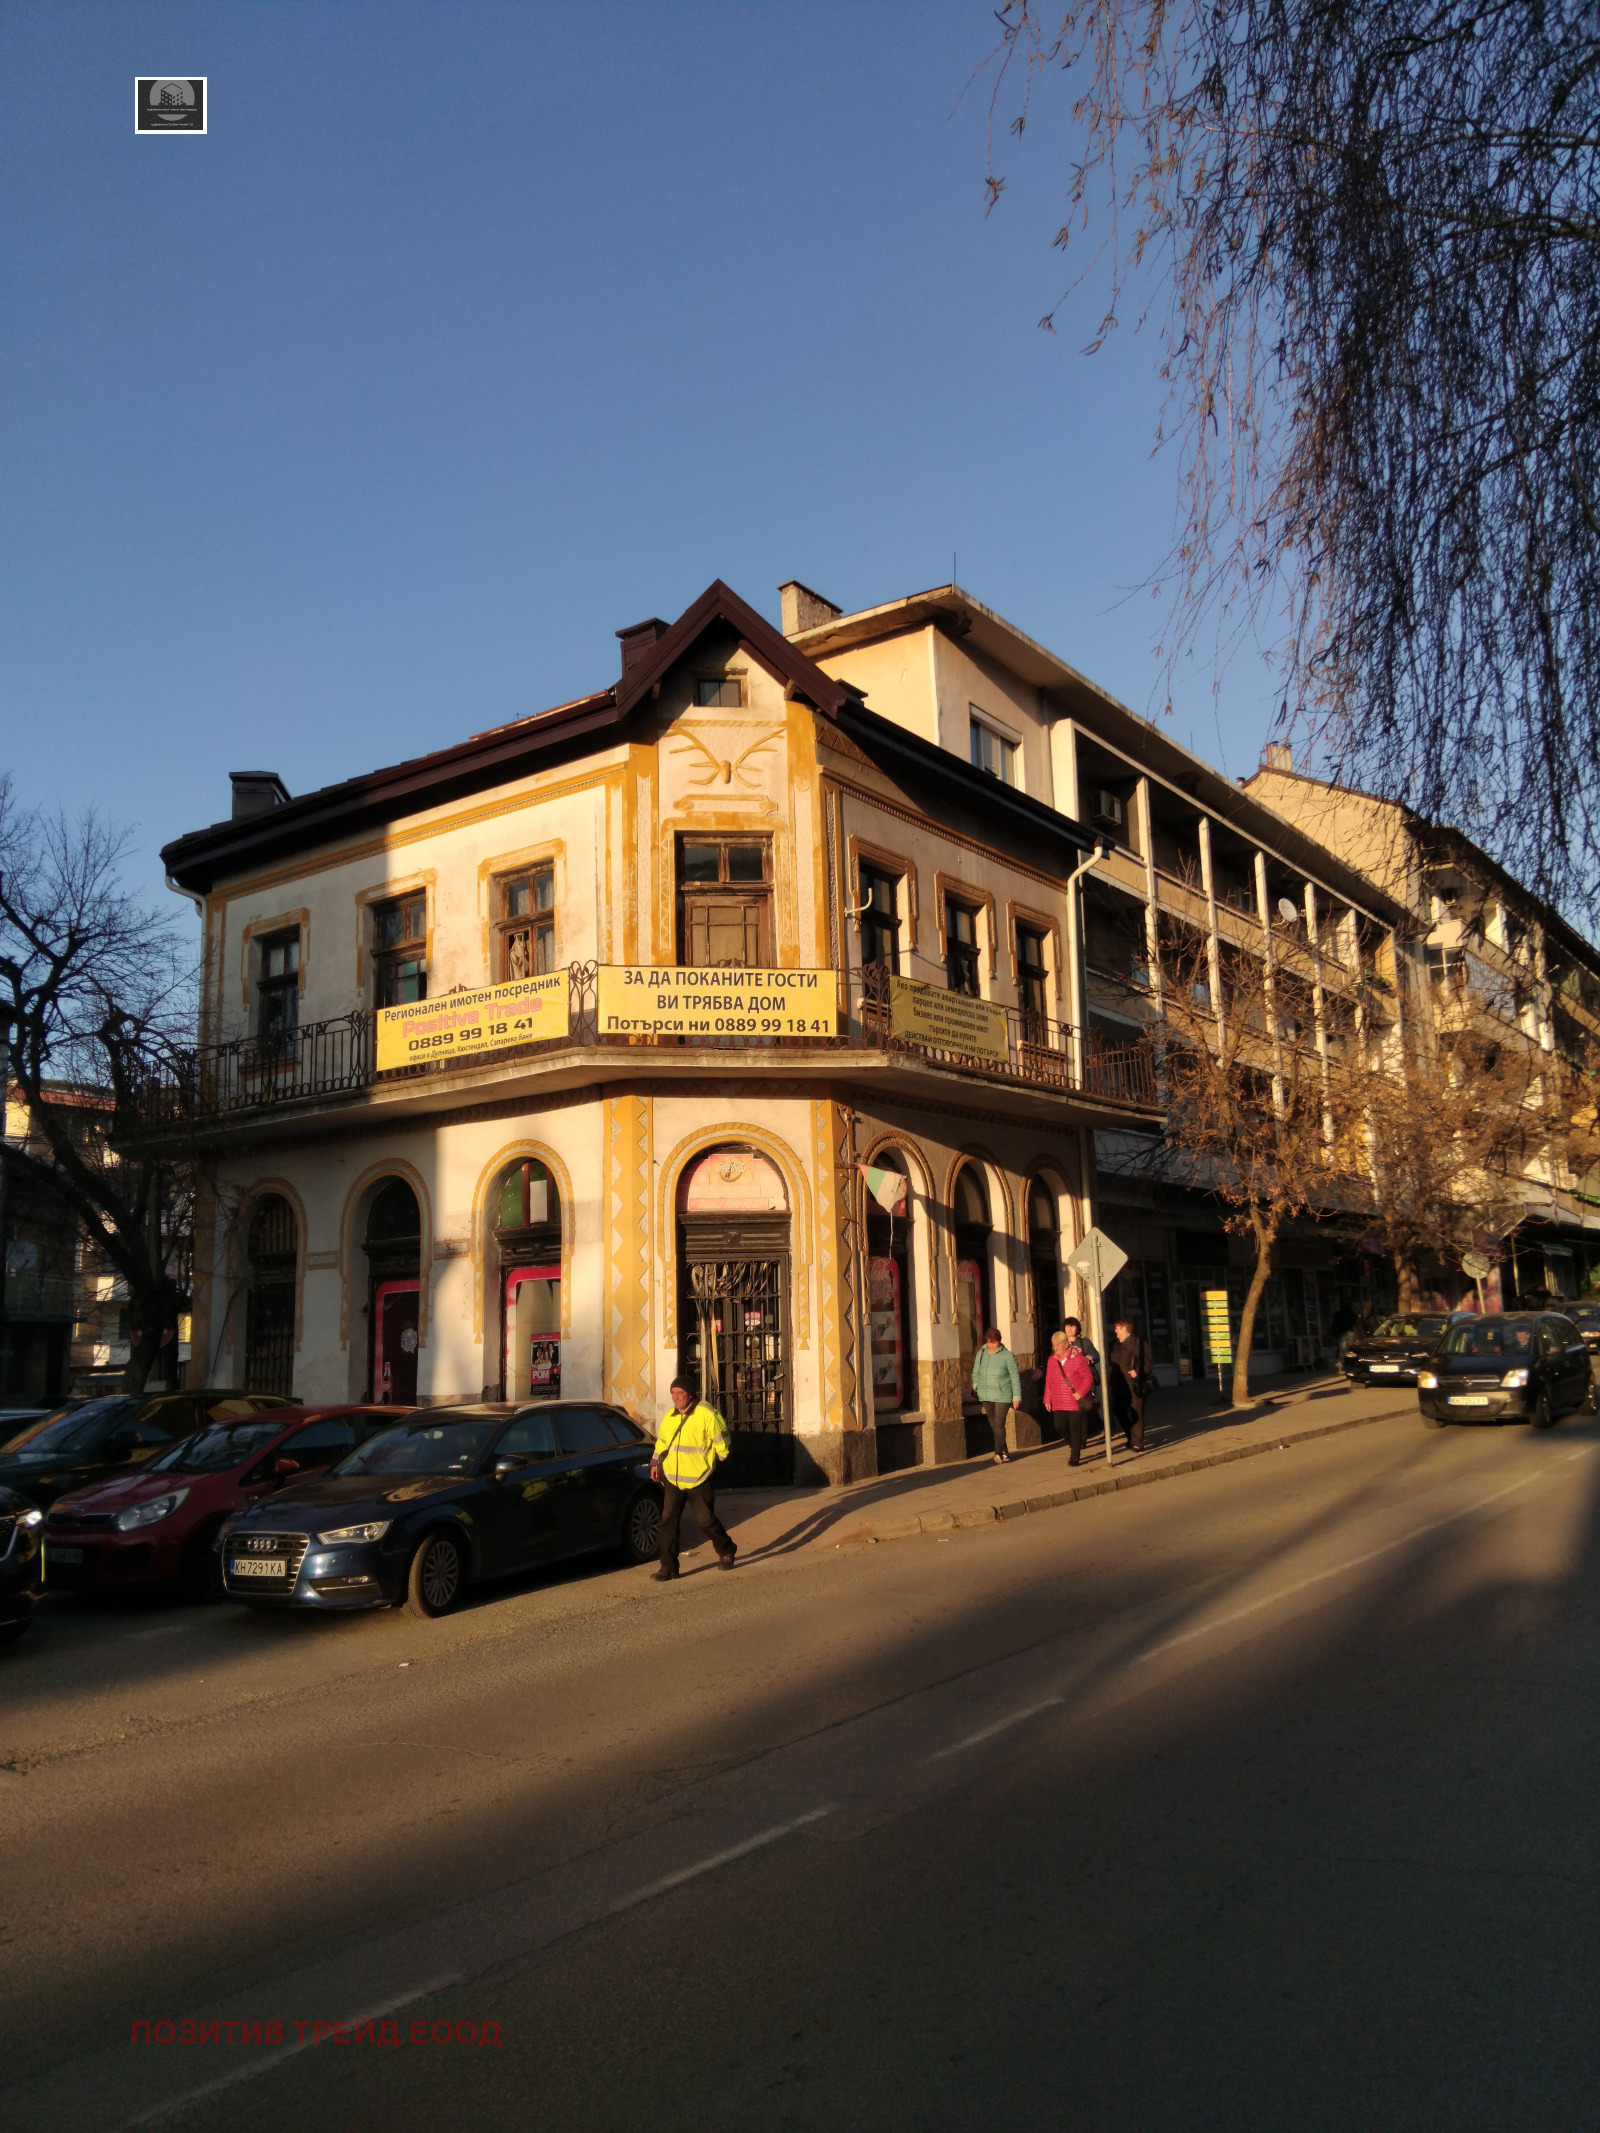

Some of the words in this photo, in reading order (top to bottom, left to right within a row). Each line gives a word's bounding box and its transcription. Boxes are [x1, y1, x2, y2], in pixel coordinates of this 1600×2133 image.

[624, 970, 644, 985] ЗА
[648, 971, 671, 988] ДА
[675, 971, 763, 987] ПОКАНИТЕ
[767, 973, 818, 988] ГОСТИ
[896, 980, 908, 990] Ако
[909, 985, 940, 999] продавате
[385, 1001, 447, 1022] Регионален
[450, 992, 491, 1009] имотен
[494, 977, 561, 999] посредник
[657, 995, 679, 1009] ВИ
[683, 995, 744, 1011] ТРЯБВА
[747, 997, 786, 1013] ДОМ
[403, 1011, 479, 1038] Positive
[485, 997, 542, 1020] Trade
[607, 1016, 684, 1034] Потърси
[688, 1019, 710, 1031] ни
[715, 1018, 757, 1032] 0889
[761, 1019, 782, 1032] 99
[787, 1019, 807, 1033] 18
[811, 1019, 829, 1033] 41
[409, 1033, 453, 1051] 0889
[460, 1027, 482, 1041] 99
[488, 1022, 507, 1035] 18
[514, 1017, 533, 1029] 41
